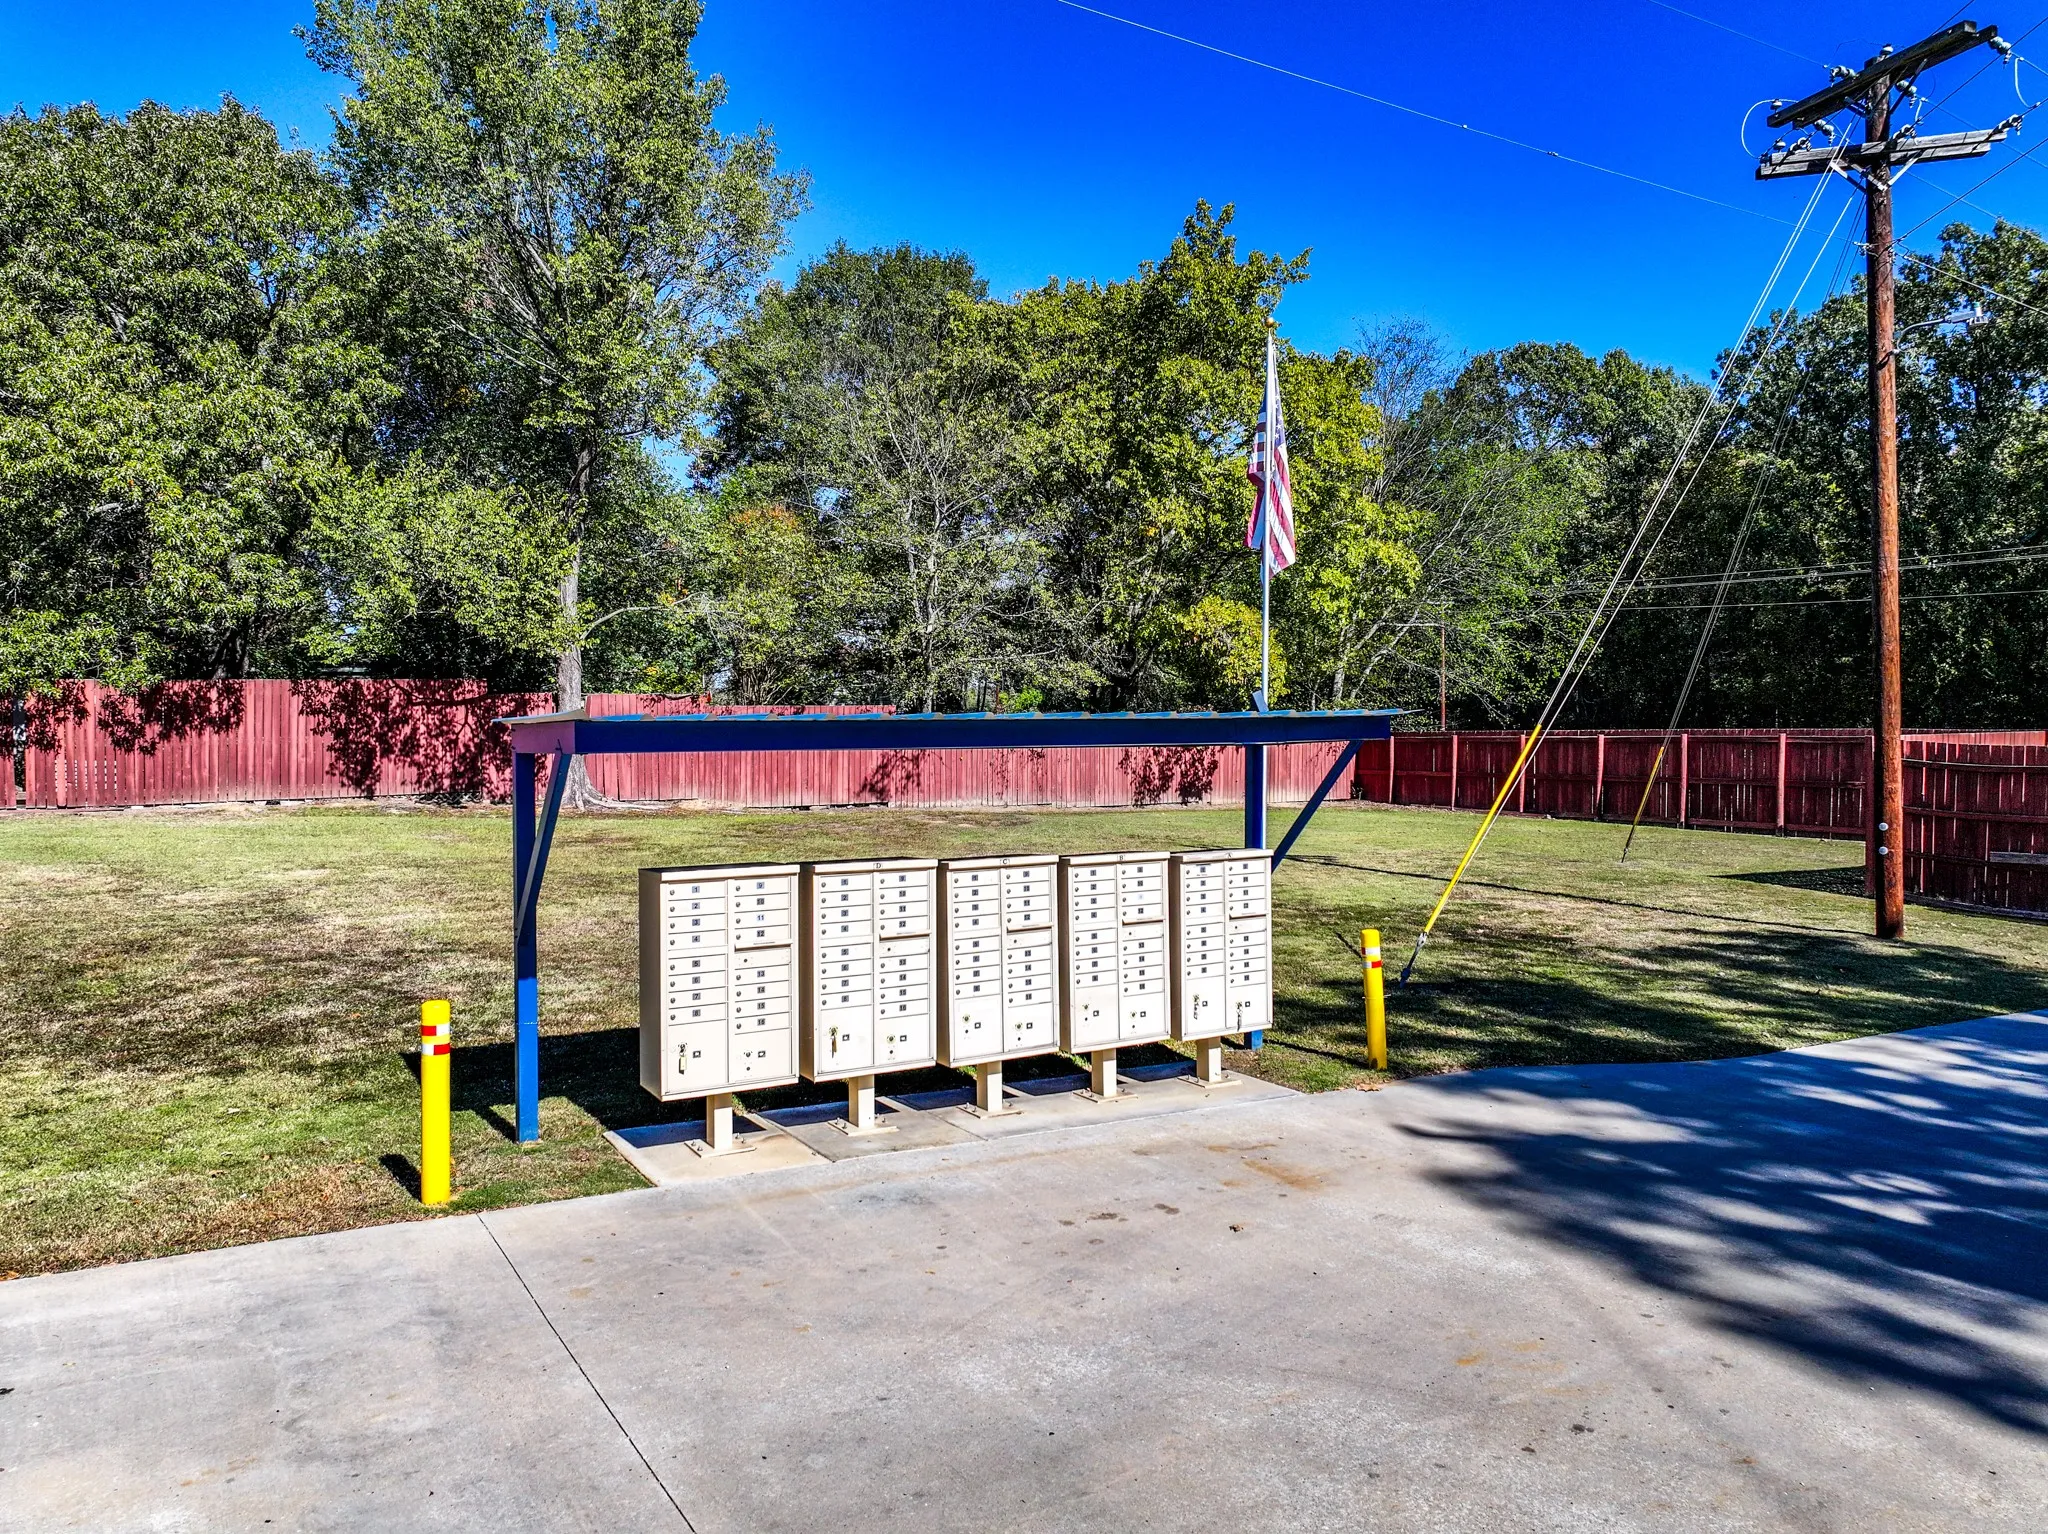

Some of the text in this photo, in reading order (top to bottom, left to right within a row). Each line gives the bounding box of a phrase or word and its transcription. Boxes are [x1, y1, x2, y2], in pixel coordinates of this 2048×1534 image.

[757, 970, 765, 978] 13
[757, 1002, 765, 1010] 15
[757, 1018, 766, 1026] 16
